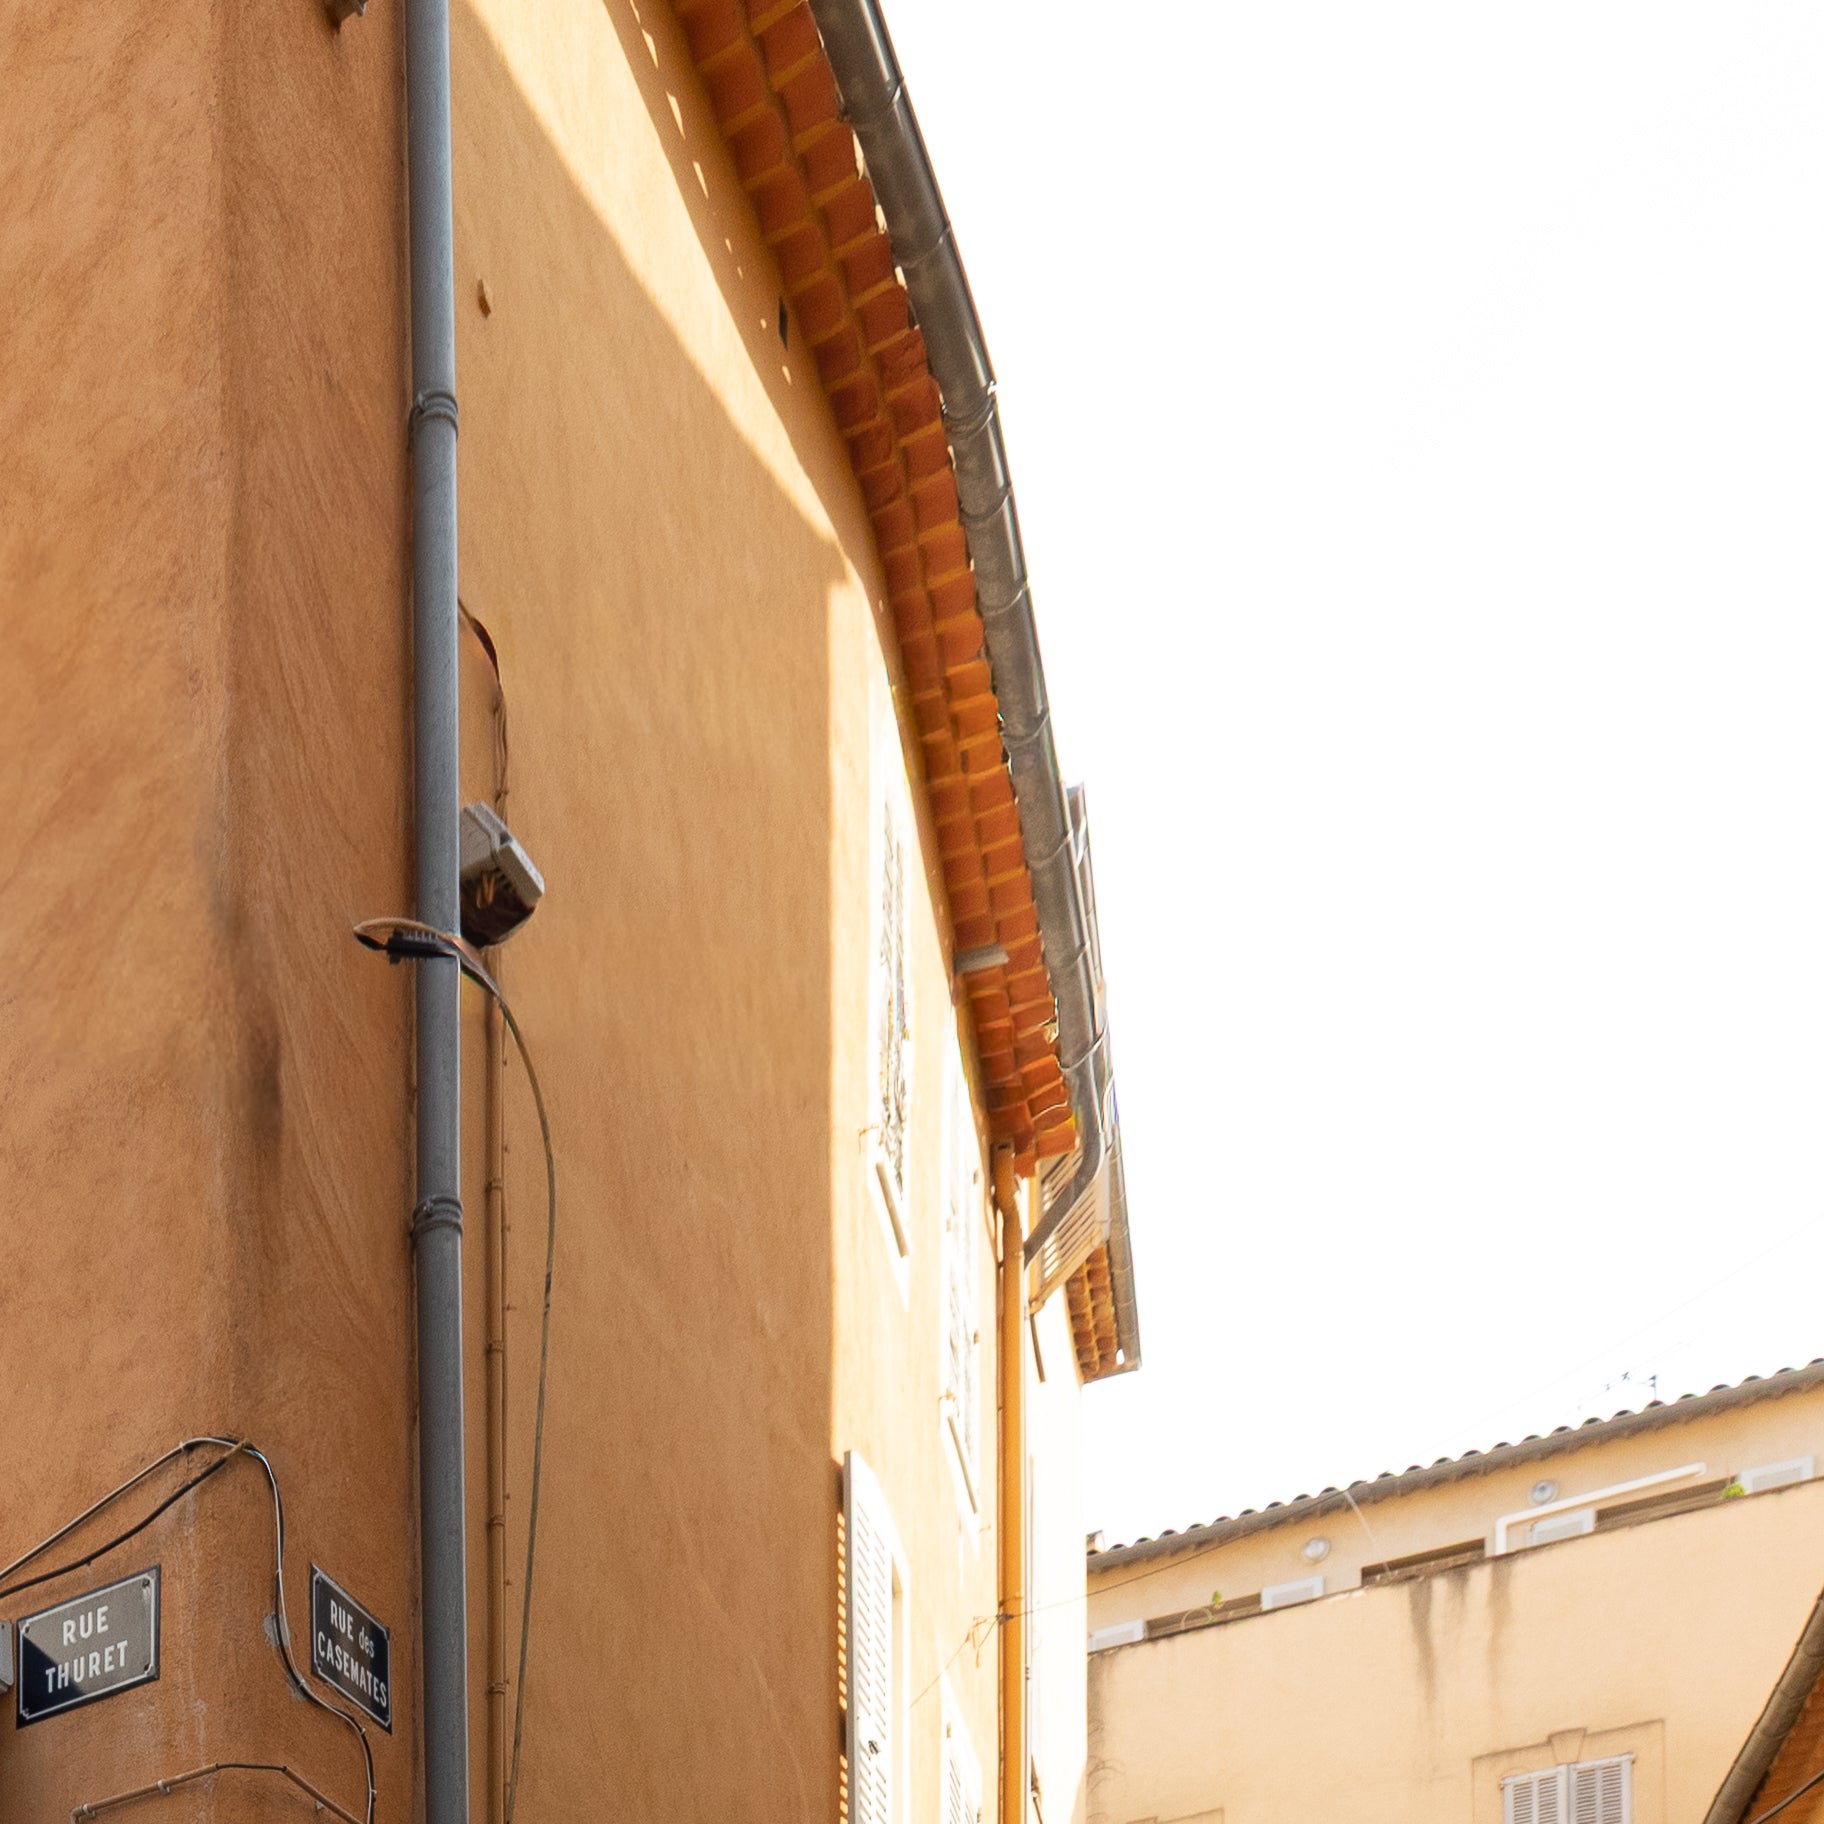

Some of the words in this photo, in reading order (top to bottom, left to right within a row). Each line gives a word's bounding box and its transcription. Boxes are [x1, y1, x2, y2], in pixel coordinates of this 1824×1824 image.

[62, 1605, 109, 1647] RUE
[330, 1599, 354, 1641] RUE
[358, 1622, 375, 1659] des
[45, 1640, 128, 1694] THURET
[317, 1631, 387, 1709] CASEMATES
